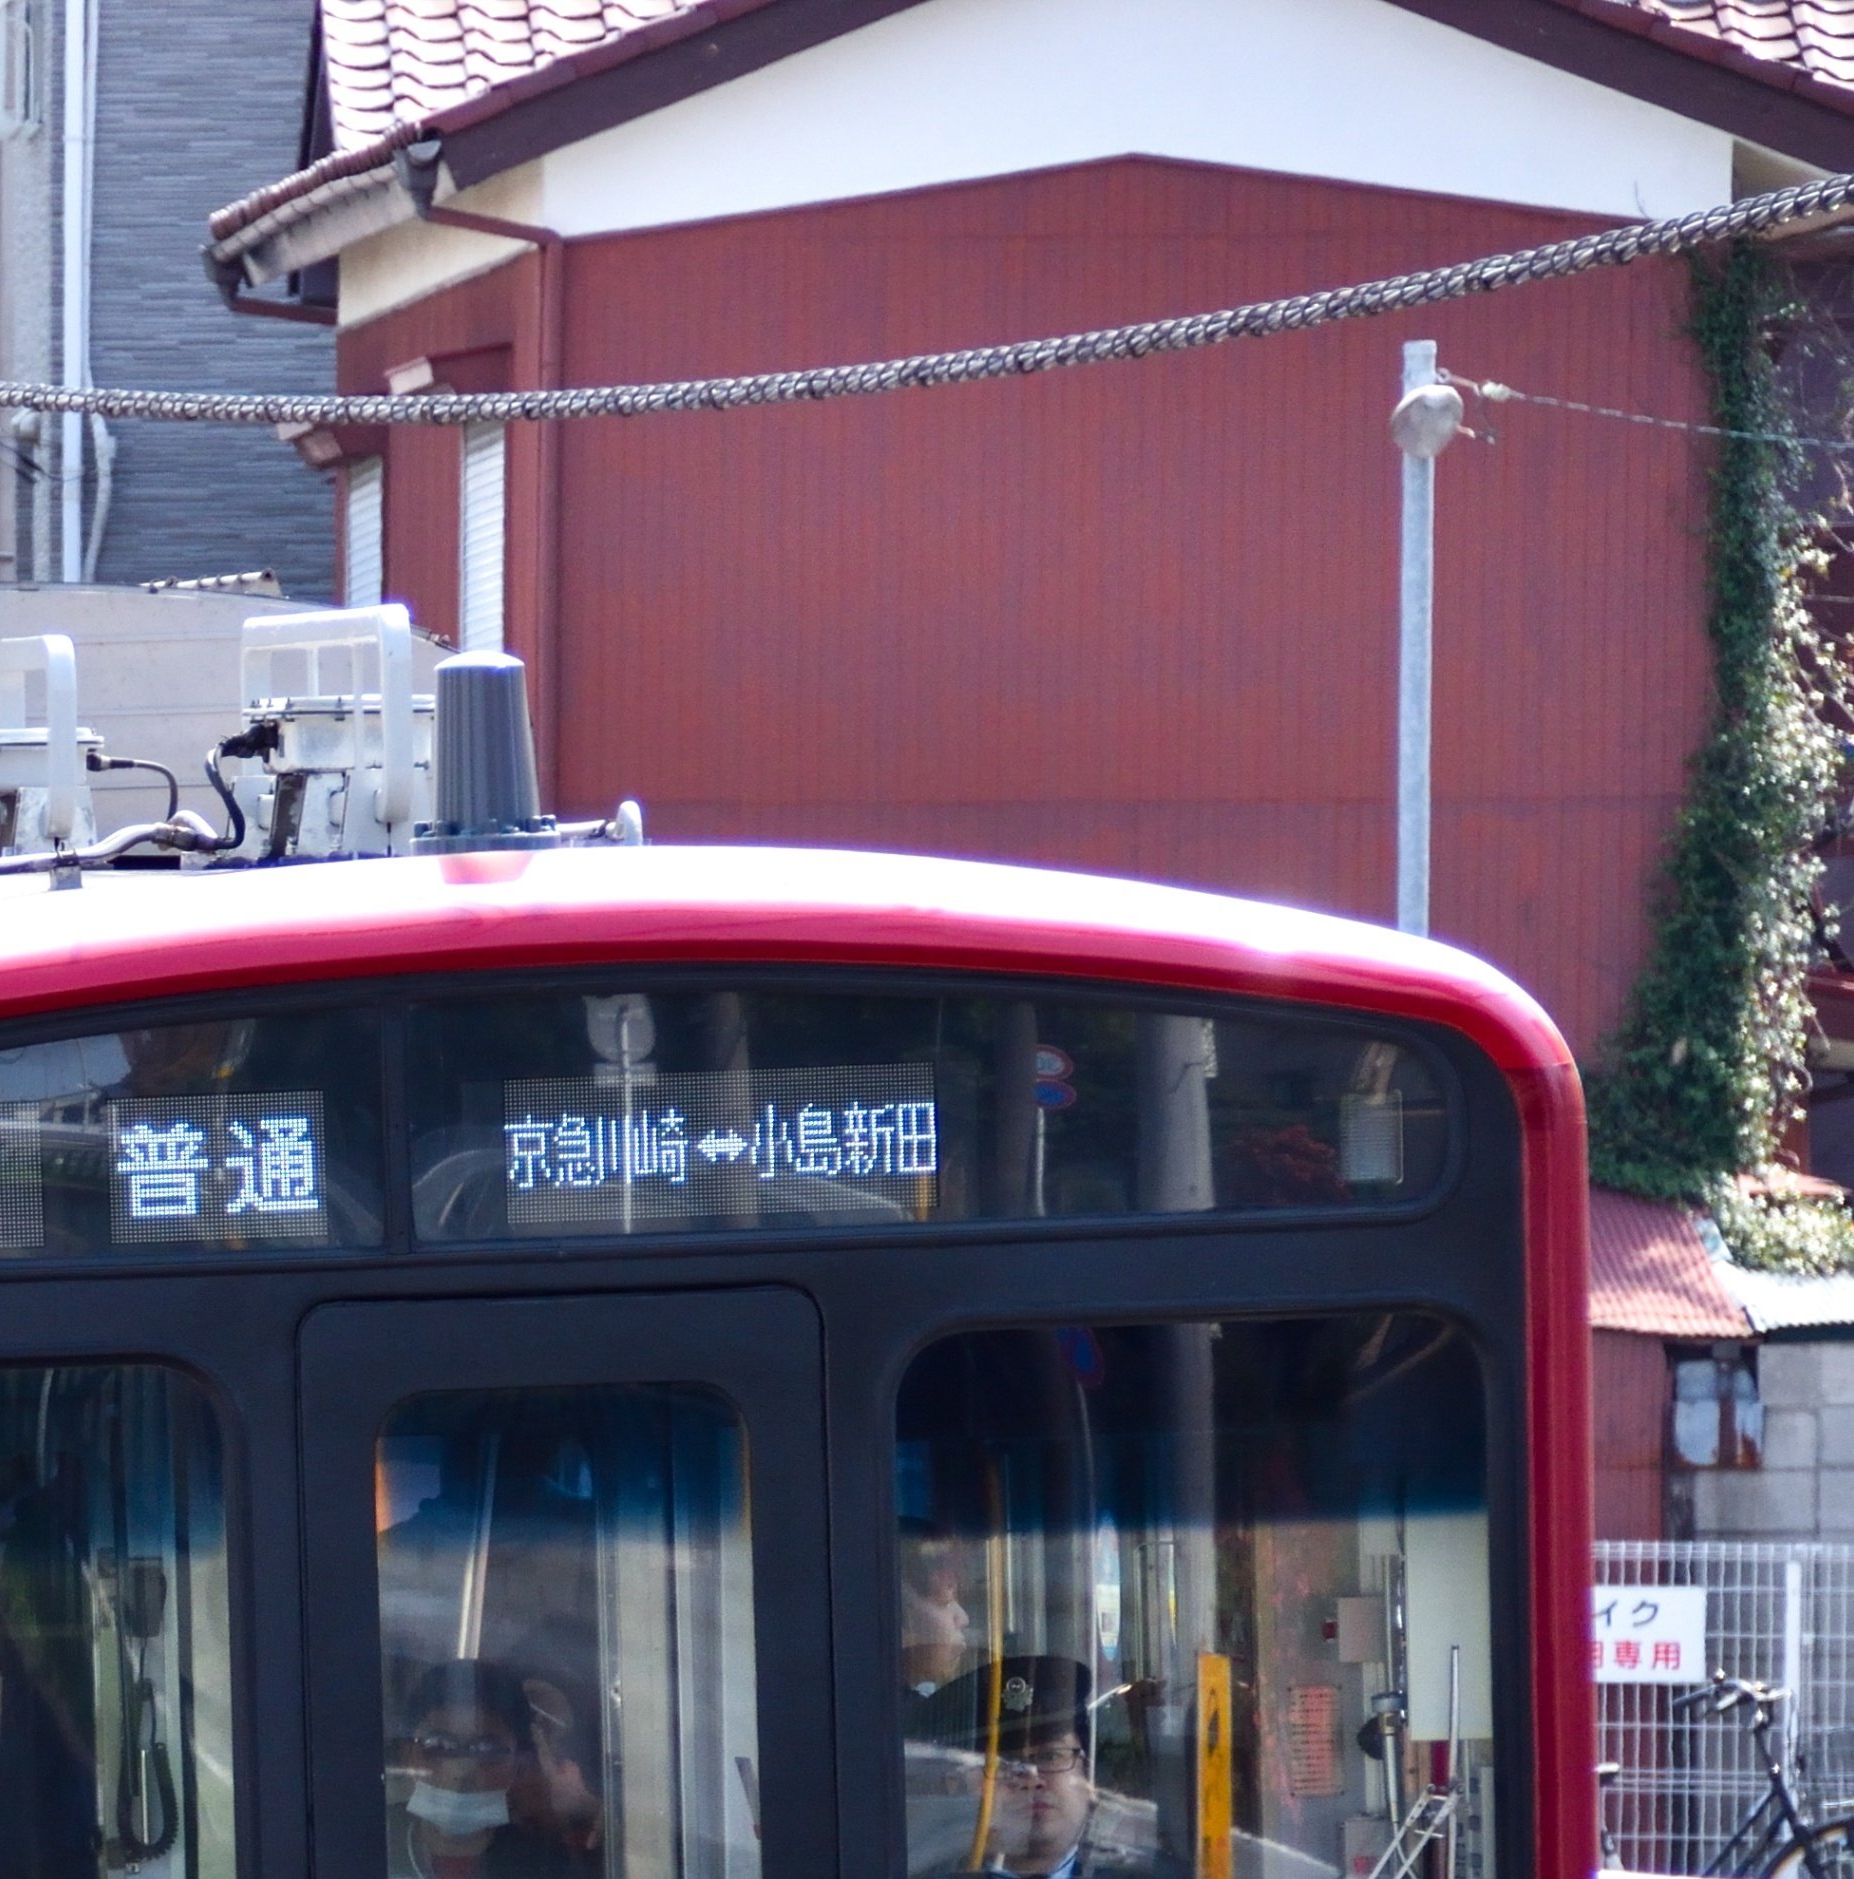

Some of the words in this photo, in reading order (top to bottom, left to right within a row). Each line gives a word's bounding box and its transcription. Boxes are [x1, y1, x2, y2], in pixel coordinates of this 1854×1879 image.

[116, 1116, 320, 1219] 普通
[503, 1108, 689, 1189] 京急川崎
[750, 1100, 938, 1179] 小島新田
